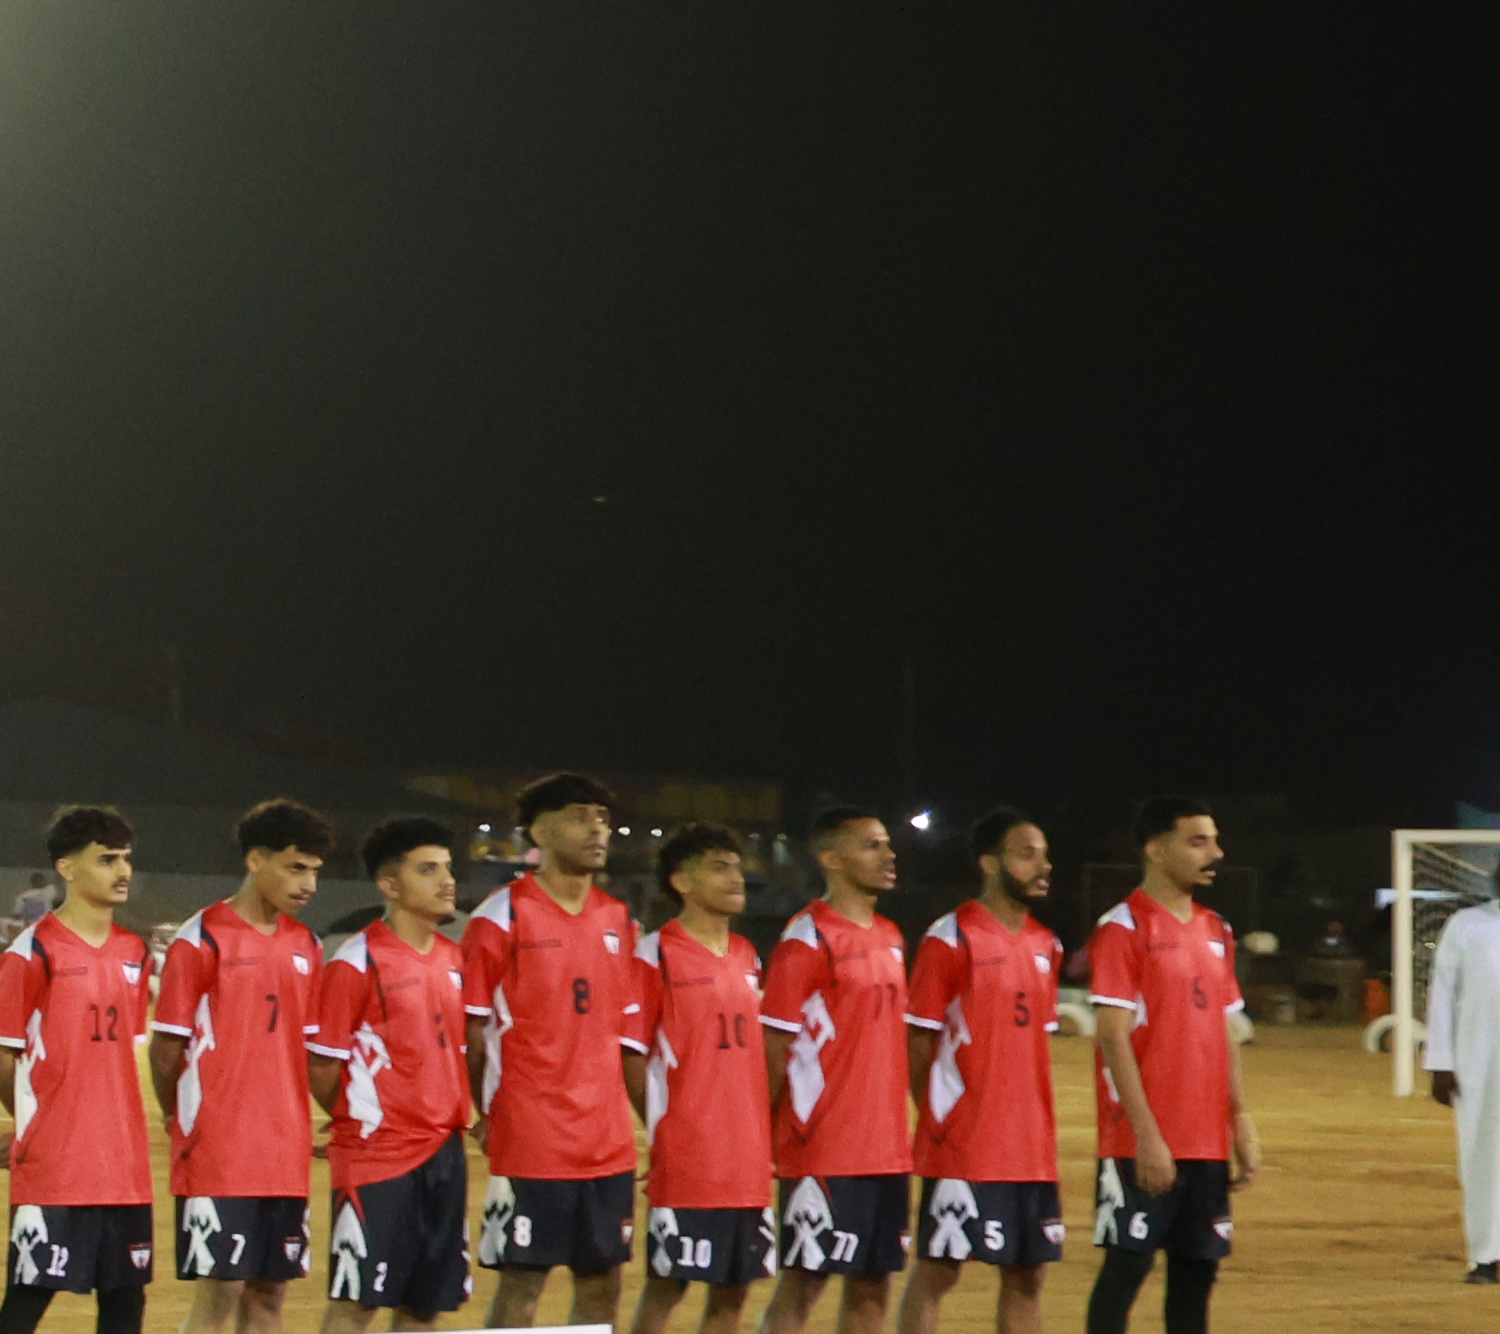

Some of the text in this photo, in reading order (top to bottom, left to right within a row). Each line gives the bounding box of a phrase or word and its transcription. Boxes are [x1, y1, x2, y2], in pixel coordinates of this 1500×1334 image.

[265, 993, 279, 1034] 7
[572, 977, 591, 1015] 8
[1014, 991, 1031, 1028] 5
[90, 1004, 118, 1042] 12
[512, 1214, 533, 1248] 8
[983, 1218, 1006, 1252] 5
[1128, 1211, 1149, 1240] 6
[45, 1243, 69, 1278] 12
[228, 1233, 247, 1266] 7
[676, 1235, 713, 1269] 10
[829, 1229, 860, 1264] 77
